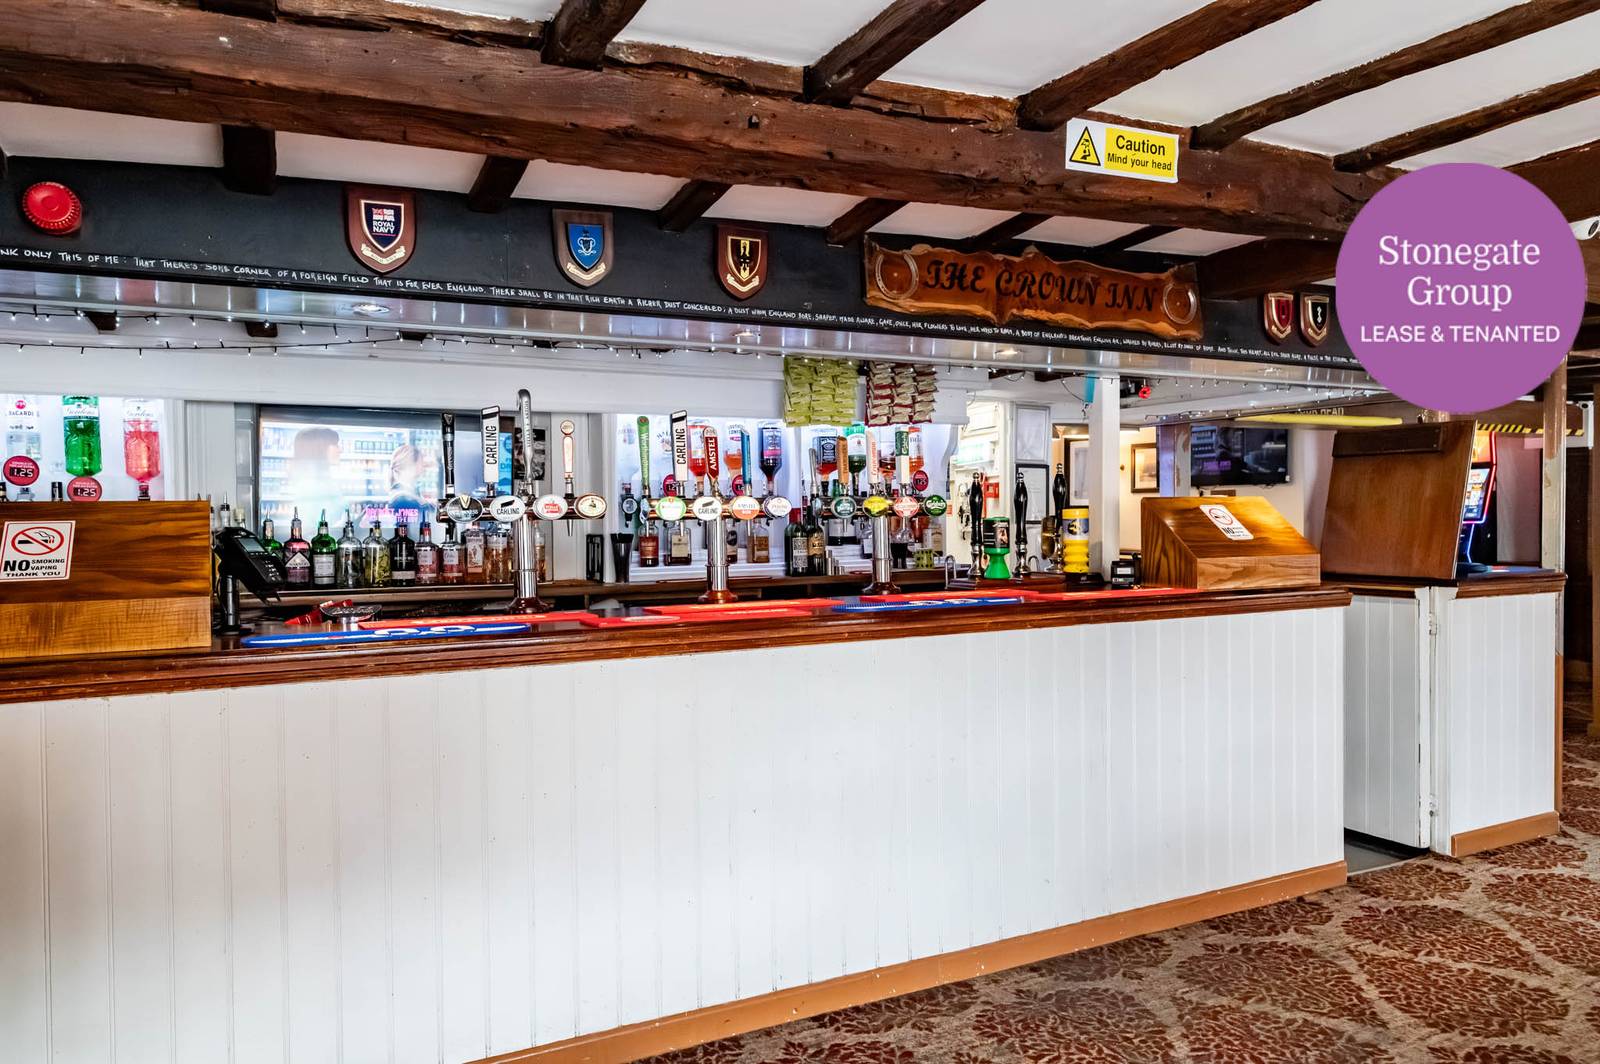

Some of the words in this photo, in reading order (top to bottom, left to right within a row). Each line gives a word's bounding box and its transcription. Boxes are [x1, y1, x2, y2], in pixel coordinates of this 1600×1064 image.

[1116, 135, 1166, 156] Caution
[1108, 153, 1128, 164] Mind
[1130, 158, 1149, 168] your
[1152, 160, 1172, 170] head
[372, 226, 396, 234] NAVY
[24, 250, 52, 258] ONLY
[58, 252, 82, 261] THIS
[88, 254, 99, 262] OF
[134, 257, 156, 267] THAT
[160, 260, 197, 270] THERE'S
[234, 266, 271, 276] CORNER
[278, 269, 288, 277] OF
[300, 272, 337, 283] FOREIGN
[342, 275, 369, 284] FIELD
[374, 277, 391, 286] THAT
[406, 280, 418, 291] FOR
[422, 282, 442, 292] EVER
[490, 287, 515, 296] THERE
[518, 290, 540, 299] SHALL
[544, 290, 552, 298] BE
[568, 294, 583, 304] THAT
[604, 296, 626, 304] EARTH
[768, 310, 796, 318] ENGLAND
[923, 259, 986, 294] THE
[995, 266, 1098, 306] CROWN
[1104, 281, 1158, 312] INN
[486, 425, 498, 465] CARLING
[676, 428, 687, 464] CARLING
[14, 468, 33, 477] 1.25
[78, 488, 96, 496] 1.25
[3, 560, 30, 572] NO
